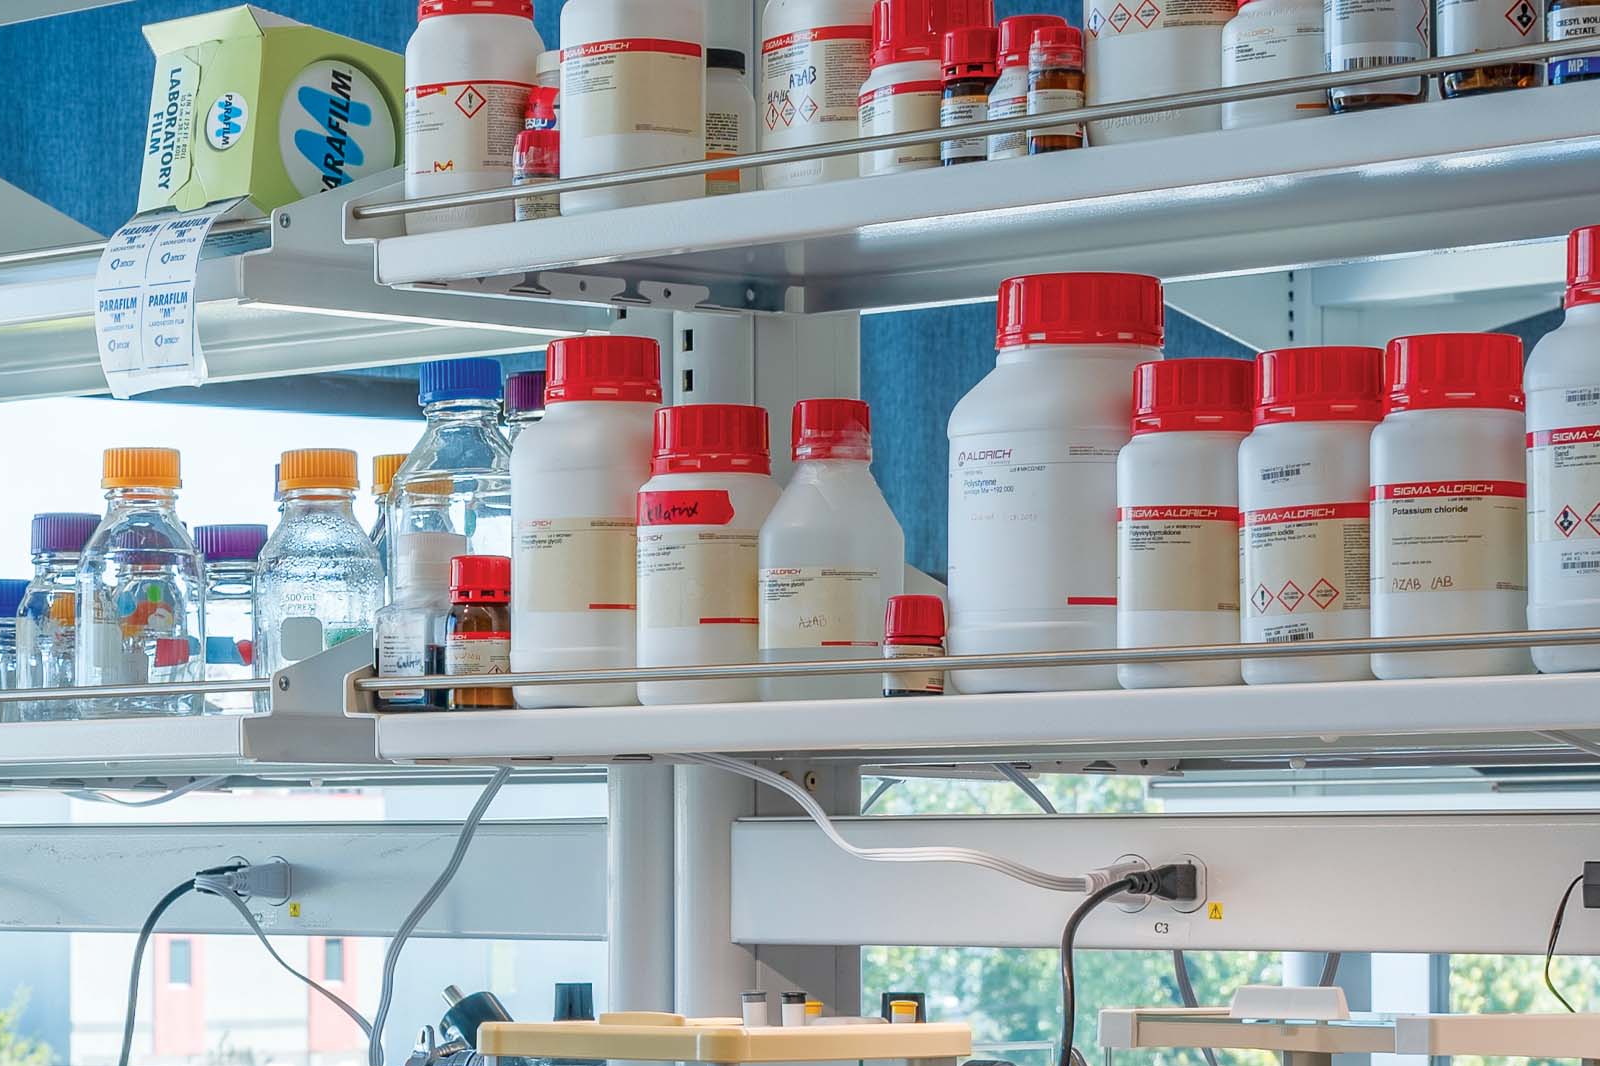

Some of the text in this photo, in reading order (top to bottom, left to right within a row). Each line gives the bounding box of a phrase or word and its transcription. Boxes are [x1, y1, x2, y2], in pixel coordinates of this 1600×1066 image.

[1565, 26, 1596, 36] ACETATE
[1568, 59, 1582, 73] MP
[221, 94, 233, 145] PARAFILM
[149, 111, 164, 155] FILM
[158, 67, 182, 190] LABORATORY
[320, 69, 353, 192] ARAFILM
[167, 216, 211, 230] PARAFILM
[99, 296, 138, 313] PARAFILM
[148, 291, 188, 308] PARAFILM
[966, 449, 1012, 461] ALDRICH
[964, 479, 997, 489] Polystyrene
[1392, 484, 1494, 497] SIGMA-ALDRICH
[1392, 505, 1469, 516] Potassium chloride
[1154, 921, 1169, 934] C3
